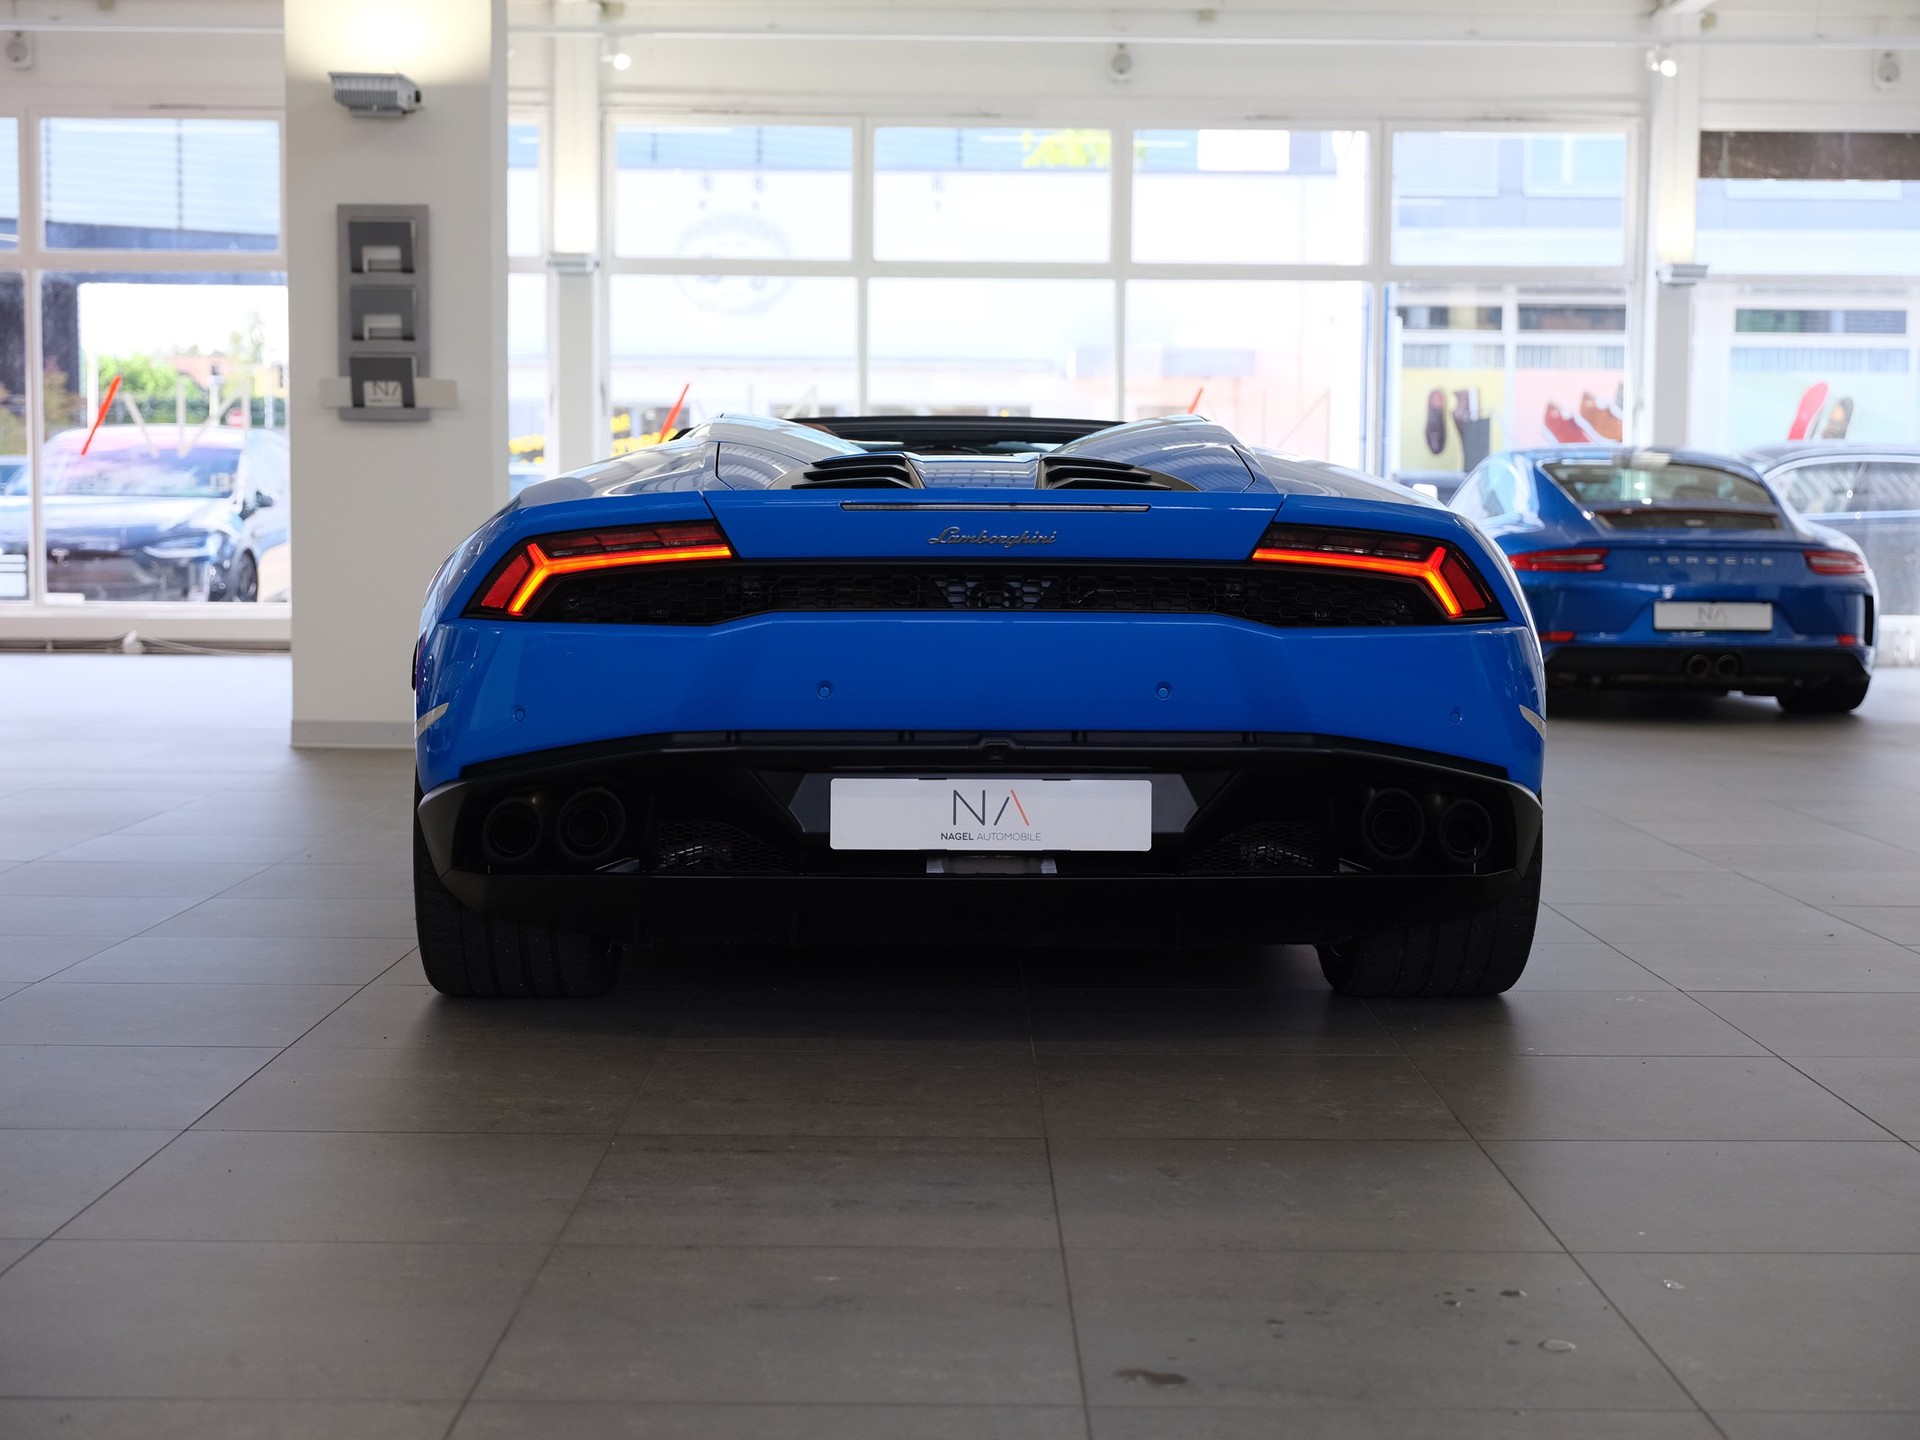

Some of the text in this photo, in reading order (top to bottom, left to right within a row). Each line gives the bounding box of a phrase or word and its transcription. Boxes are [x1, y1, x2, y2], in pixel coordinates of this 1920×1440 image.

[927, 526, 1057, 548] Lamborghini
[1647, 555, 1774, 566] PORSCHE
[952, 788, 1030, 827] NA
[940, 832, 1042, 842] NAGEL AUTOMOBILE
